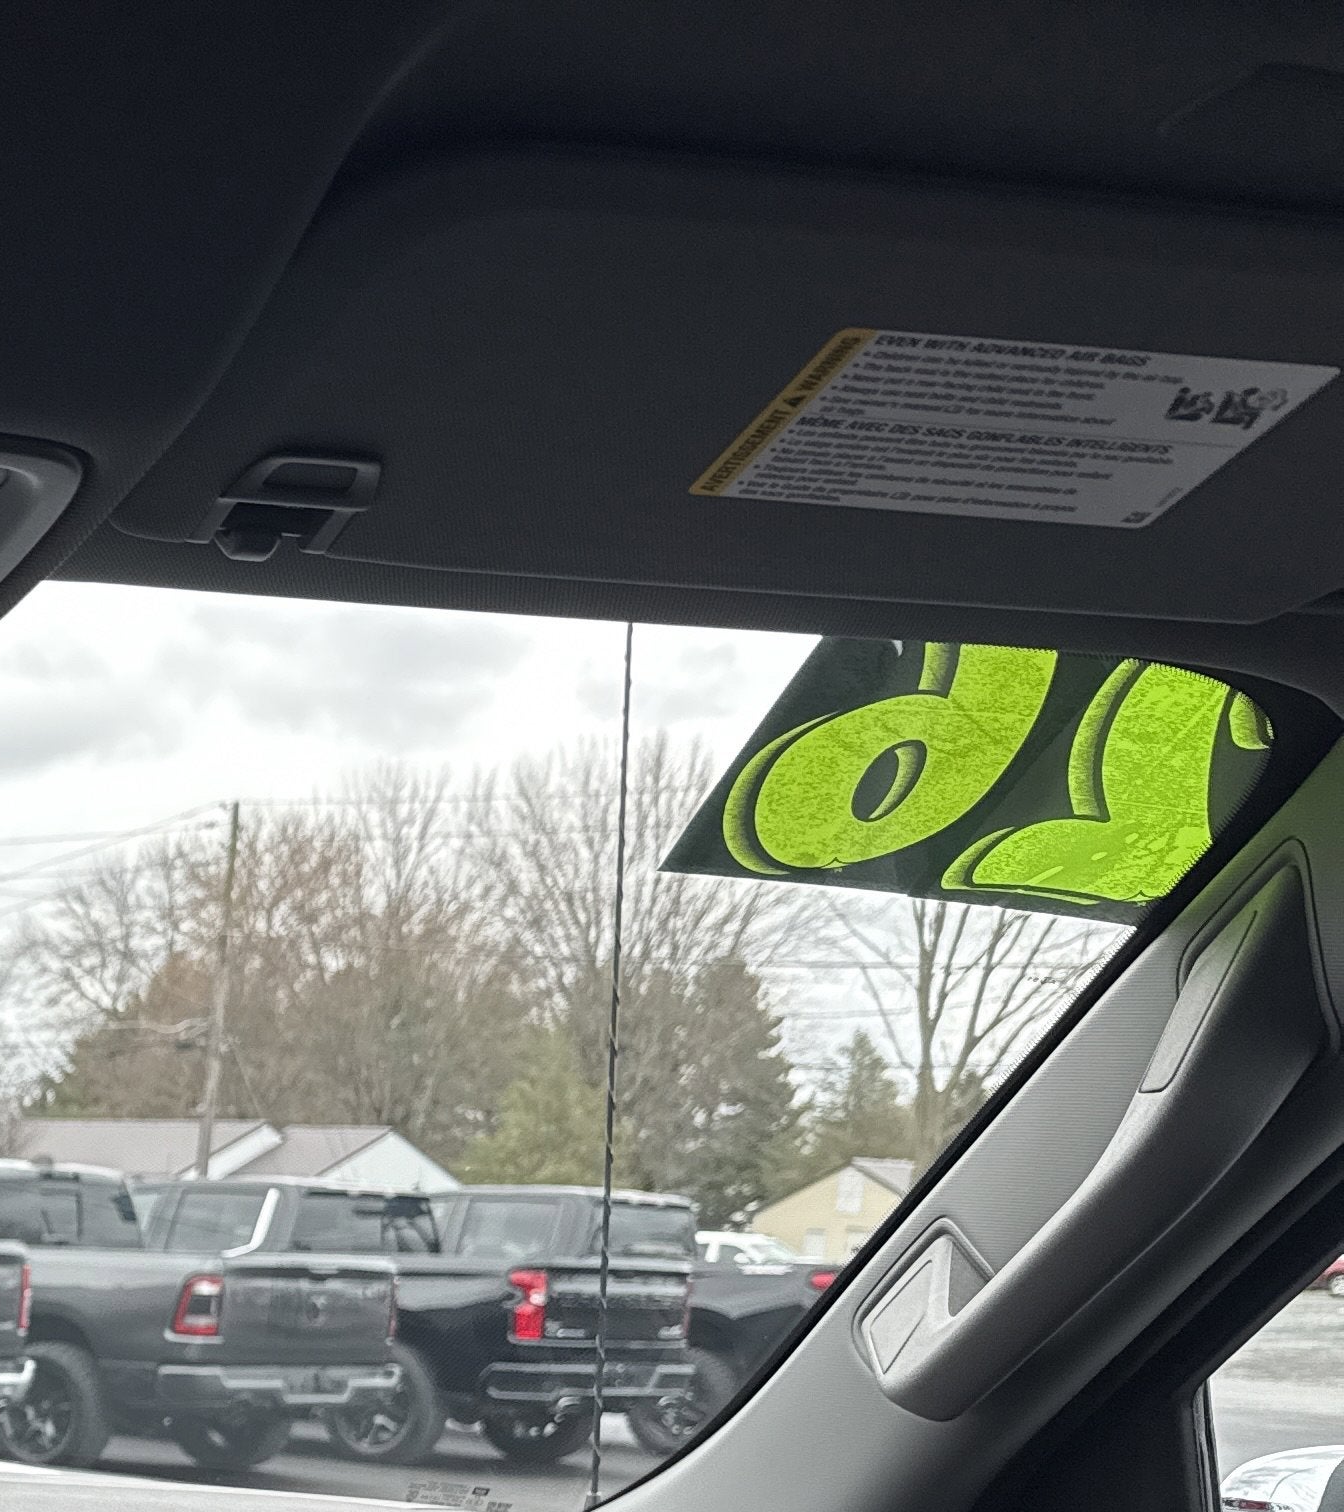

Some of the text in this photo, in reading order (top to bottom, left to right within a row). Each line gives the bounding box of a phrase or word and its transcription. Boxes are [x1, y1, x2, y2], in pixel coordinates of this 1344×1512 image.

[874, 335, 921, 348] EVEN
[969, 343, 1067, 361] ADVANCED
[699, 410, 790, 492] AVERTISSEMENT
